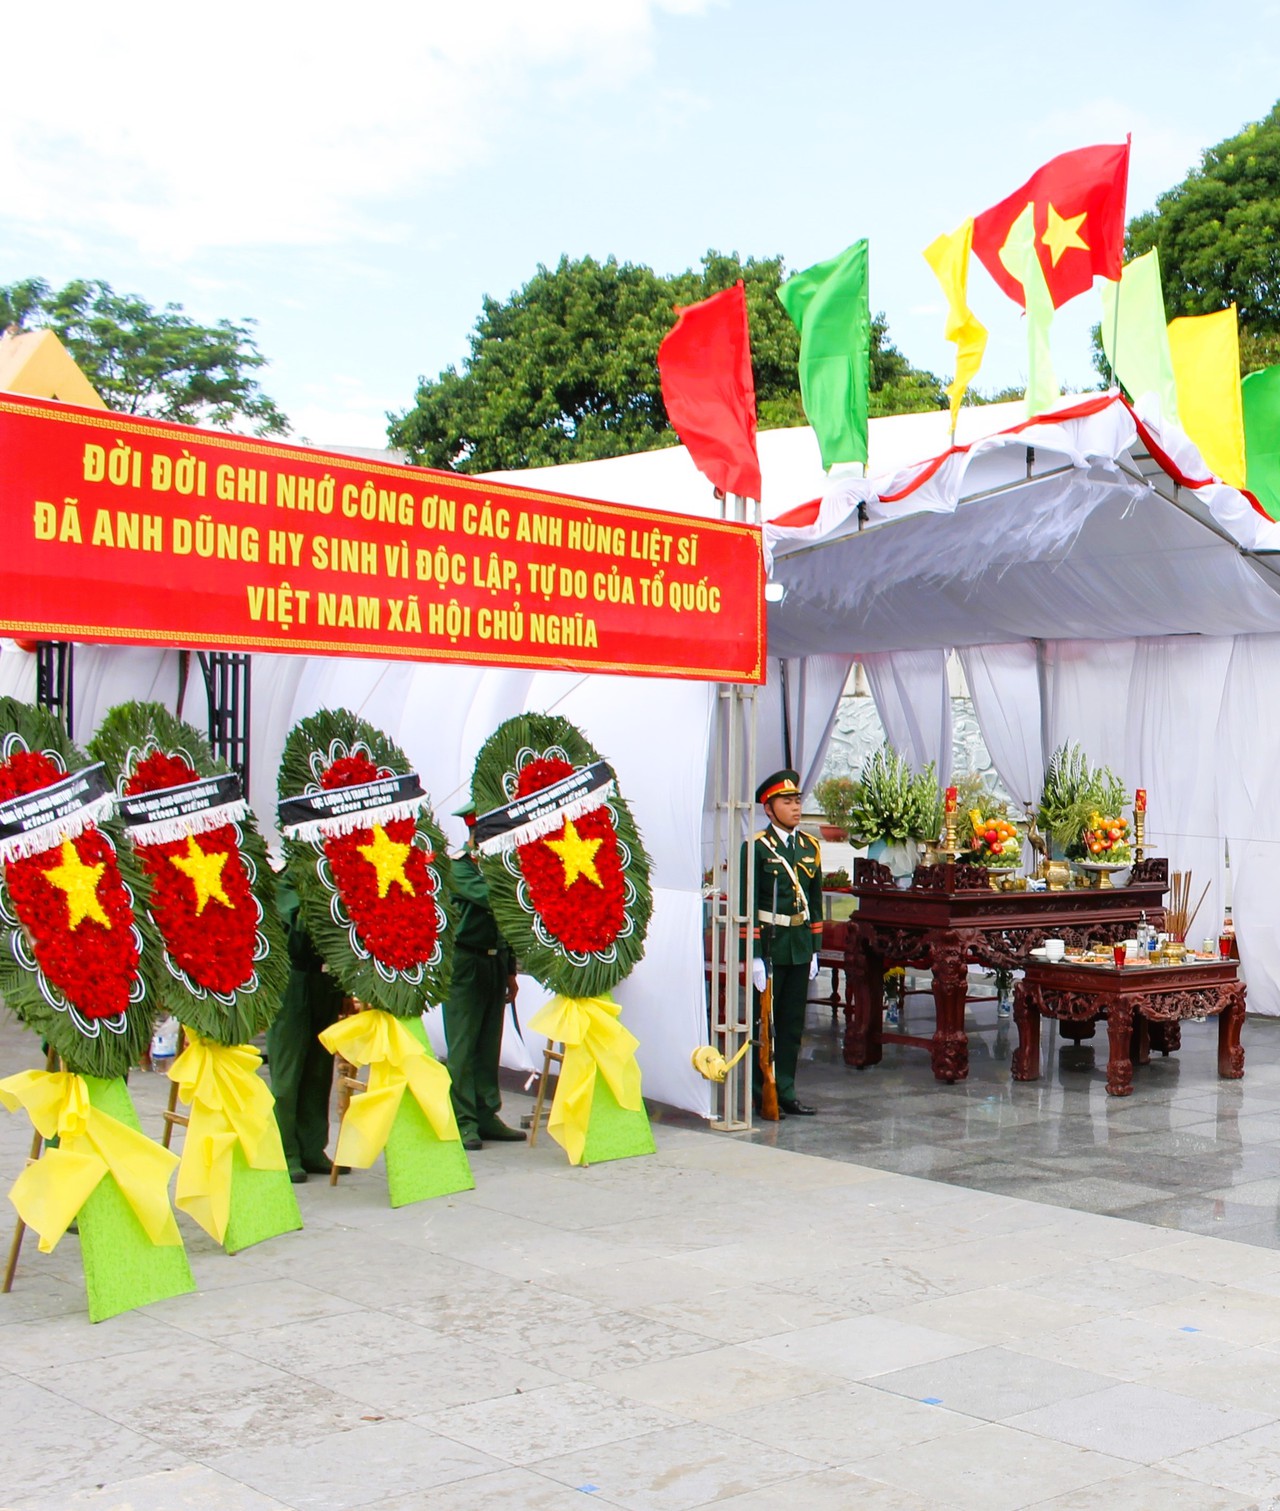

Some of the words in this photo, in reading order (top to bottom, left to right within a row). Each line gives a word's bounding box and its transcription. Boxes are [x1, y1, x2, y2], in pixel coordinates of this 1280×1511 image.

[33, 497, 82, 543] ĐÃ
[92, 509, 162, 552] ANH
[173, 514, 259, 562] DŨNG
[269, 530, 304, 566] HY
[312, 536, 377, 575] SINH
[384, 540, 409, 579] VÌ
[416, 545, 466, 590] ĐỘC
[473, 552, 521, 595] LẬP,
[528, 563, 556, 601] TỰ
[560, 568, 587, 599] DO
[593, 565, 635, 604] CỦA
[640, 570, 664, 607] TỔ
[669, 576, 720, 613] QUỐC
[83, 439, 142, 488] ĐỜI
[151, 449, 206, 496] ĐỜI
[216, 464, 267, 505] GHI
[277, 473, 335, 514] NHỚ
[342, 480, 414, 526] CÔNG
[422, 495, 456, 532] ƠN
[463, 500, 510, 539] CÁC
[516, 512, 562, 547] ANH
[568, 517, 625, 556] HÙNG
[631, 528, 673, 567] LIỆT
[677, 534, 698, 566] SĨ
[247, 582, 310, 630] VIỆT
[318, 592, 380, 630] NAM
[387, 595, 422, 633] XÃ
[429, 598, 470, 643] HỘI
[478, 601, 523, 641] CHỦ
[530, 612, 598, 648] NGHĨA
